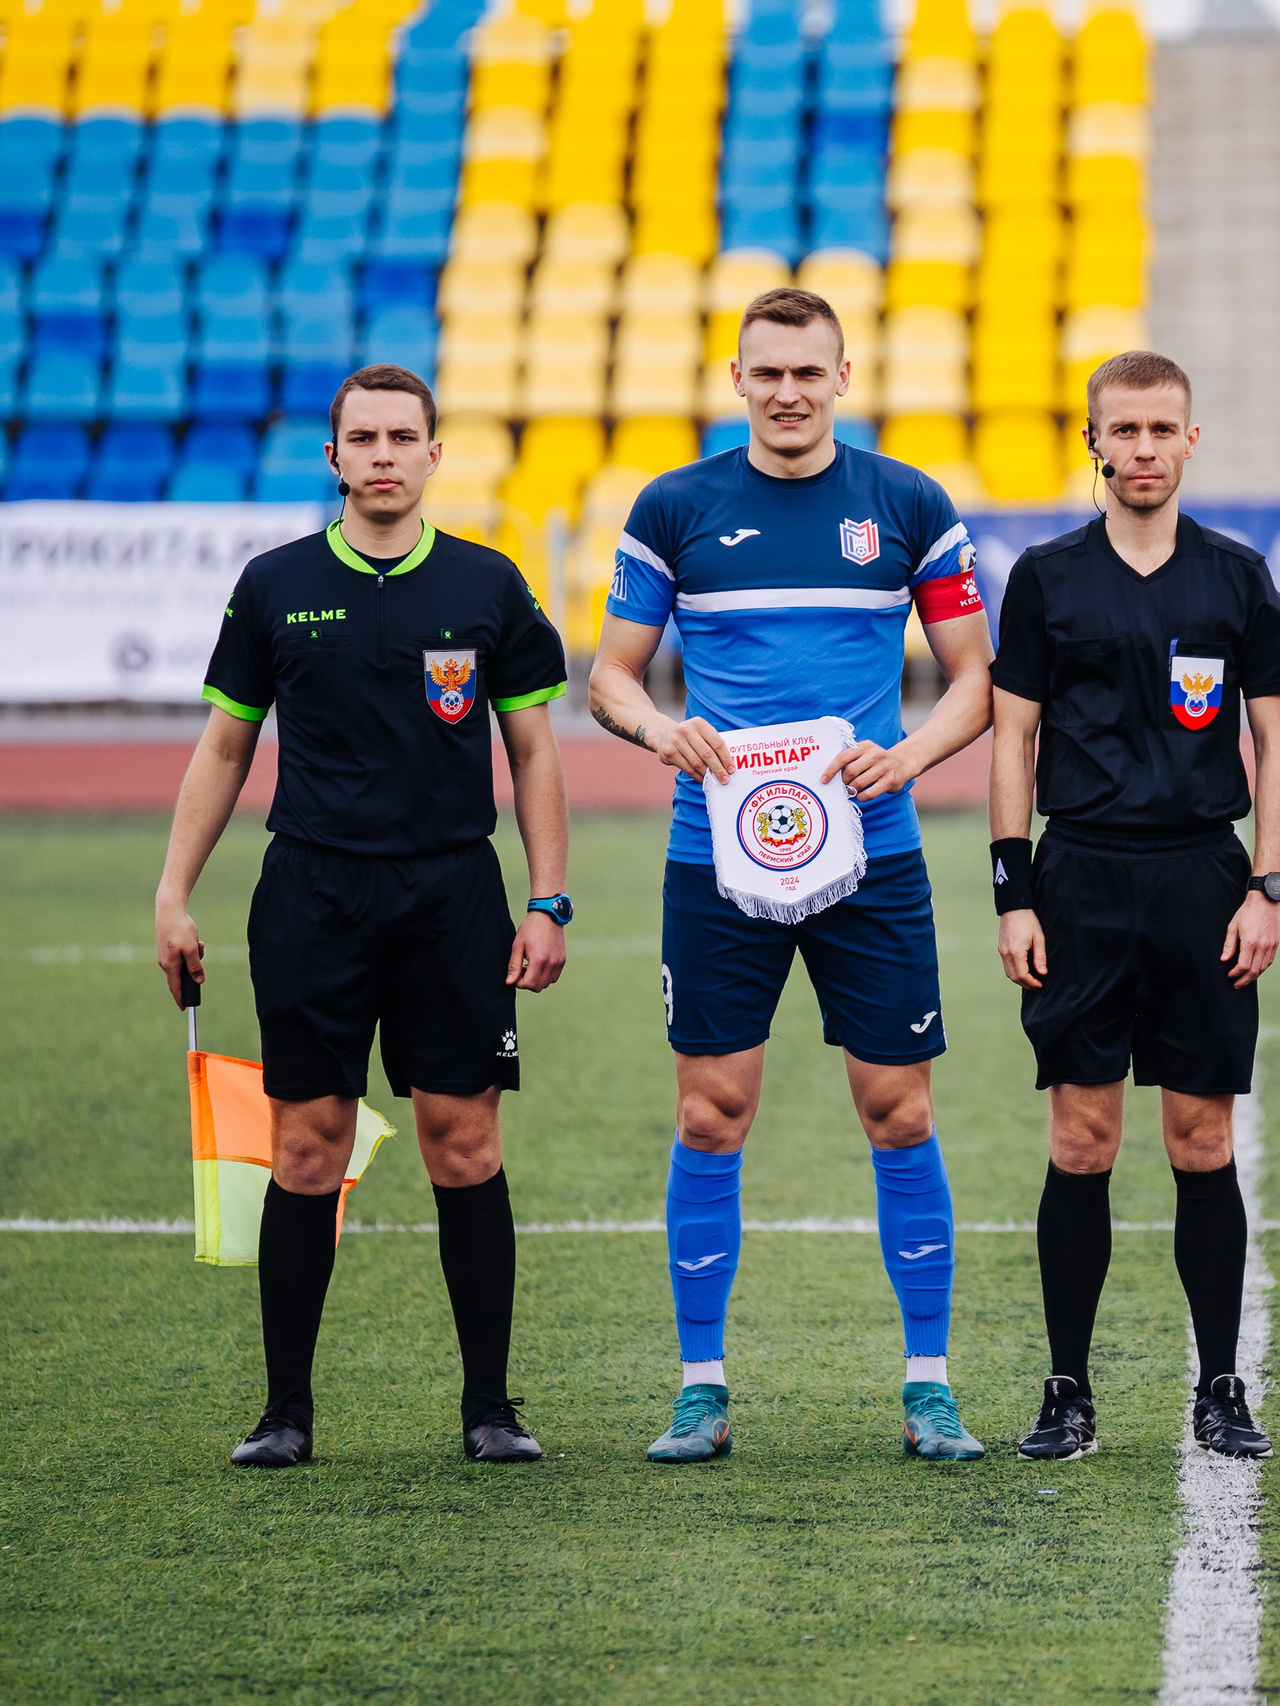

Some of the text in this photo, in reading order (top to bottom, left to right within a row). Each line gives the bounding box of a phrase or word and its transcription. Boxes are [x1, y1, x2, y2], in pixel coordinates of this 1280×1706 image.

[960, 595, 981, 607] KEL
[286, 609, 346, 624] KELME
[729, 735, 815, 754] ФУТБОЛЬНЫЙ КЛУБ
[752, 765, 798, 776] Пермский край
[751, 787, 808, 807] ФК ИЛЬПАР
[758, 845, 812, 864] ПЕРМСКИЙ КРАЙ
[780, 876, 800, 886] 2024
